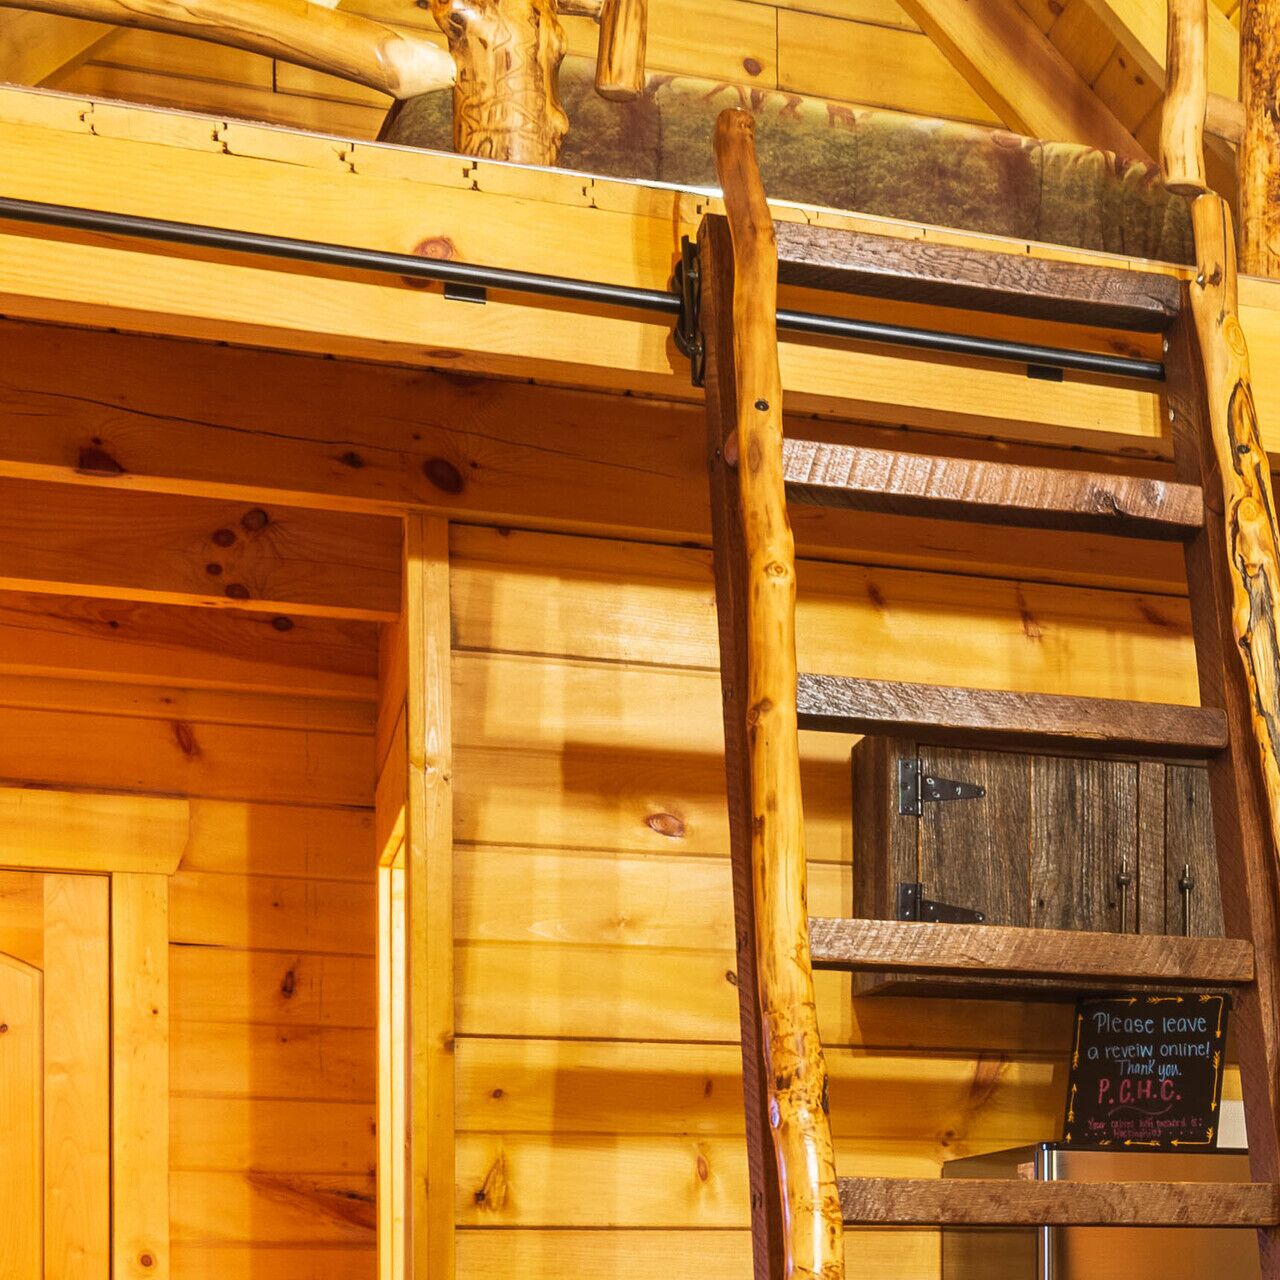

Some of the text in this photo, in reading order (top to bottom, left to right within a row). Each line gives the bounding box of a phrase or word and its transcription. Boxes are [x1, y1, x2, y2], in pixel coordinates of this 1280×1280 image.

[1093, 1012, 1207, 1034] Please leave
[1087, 1041, 1210, 1060] a reveiw online!
[1114, 1059, 1155, 1076] Thank
